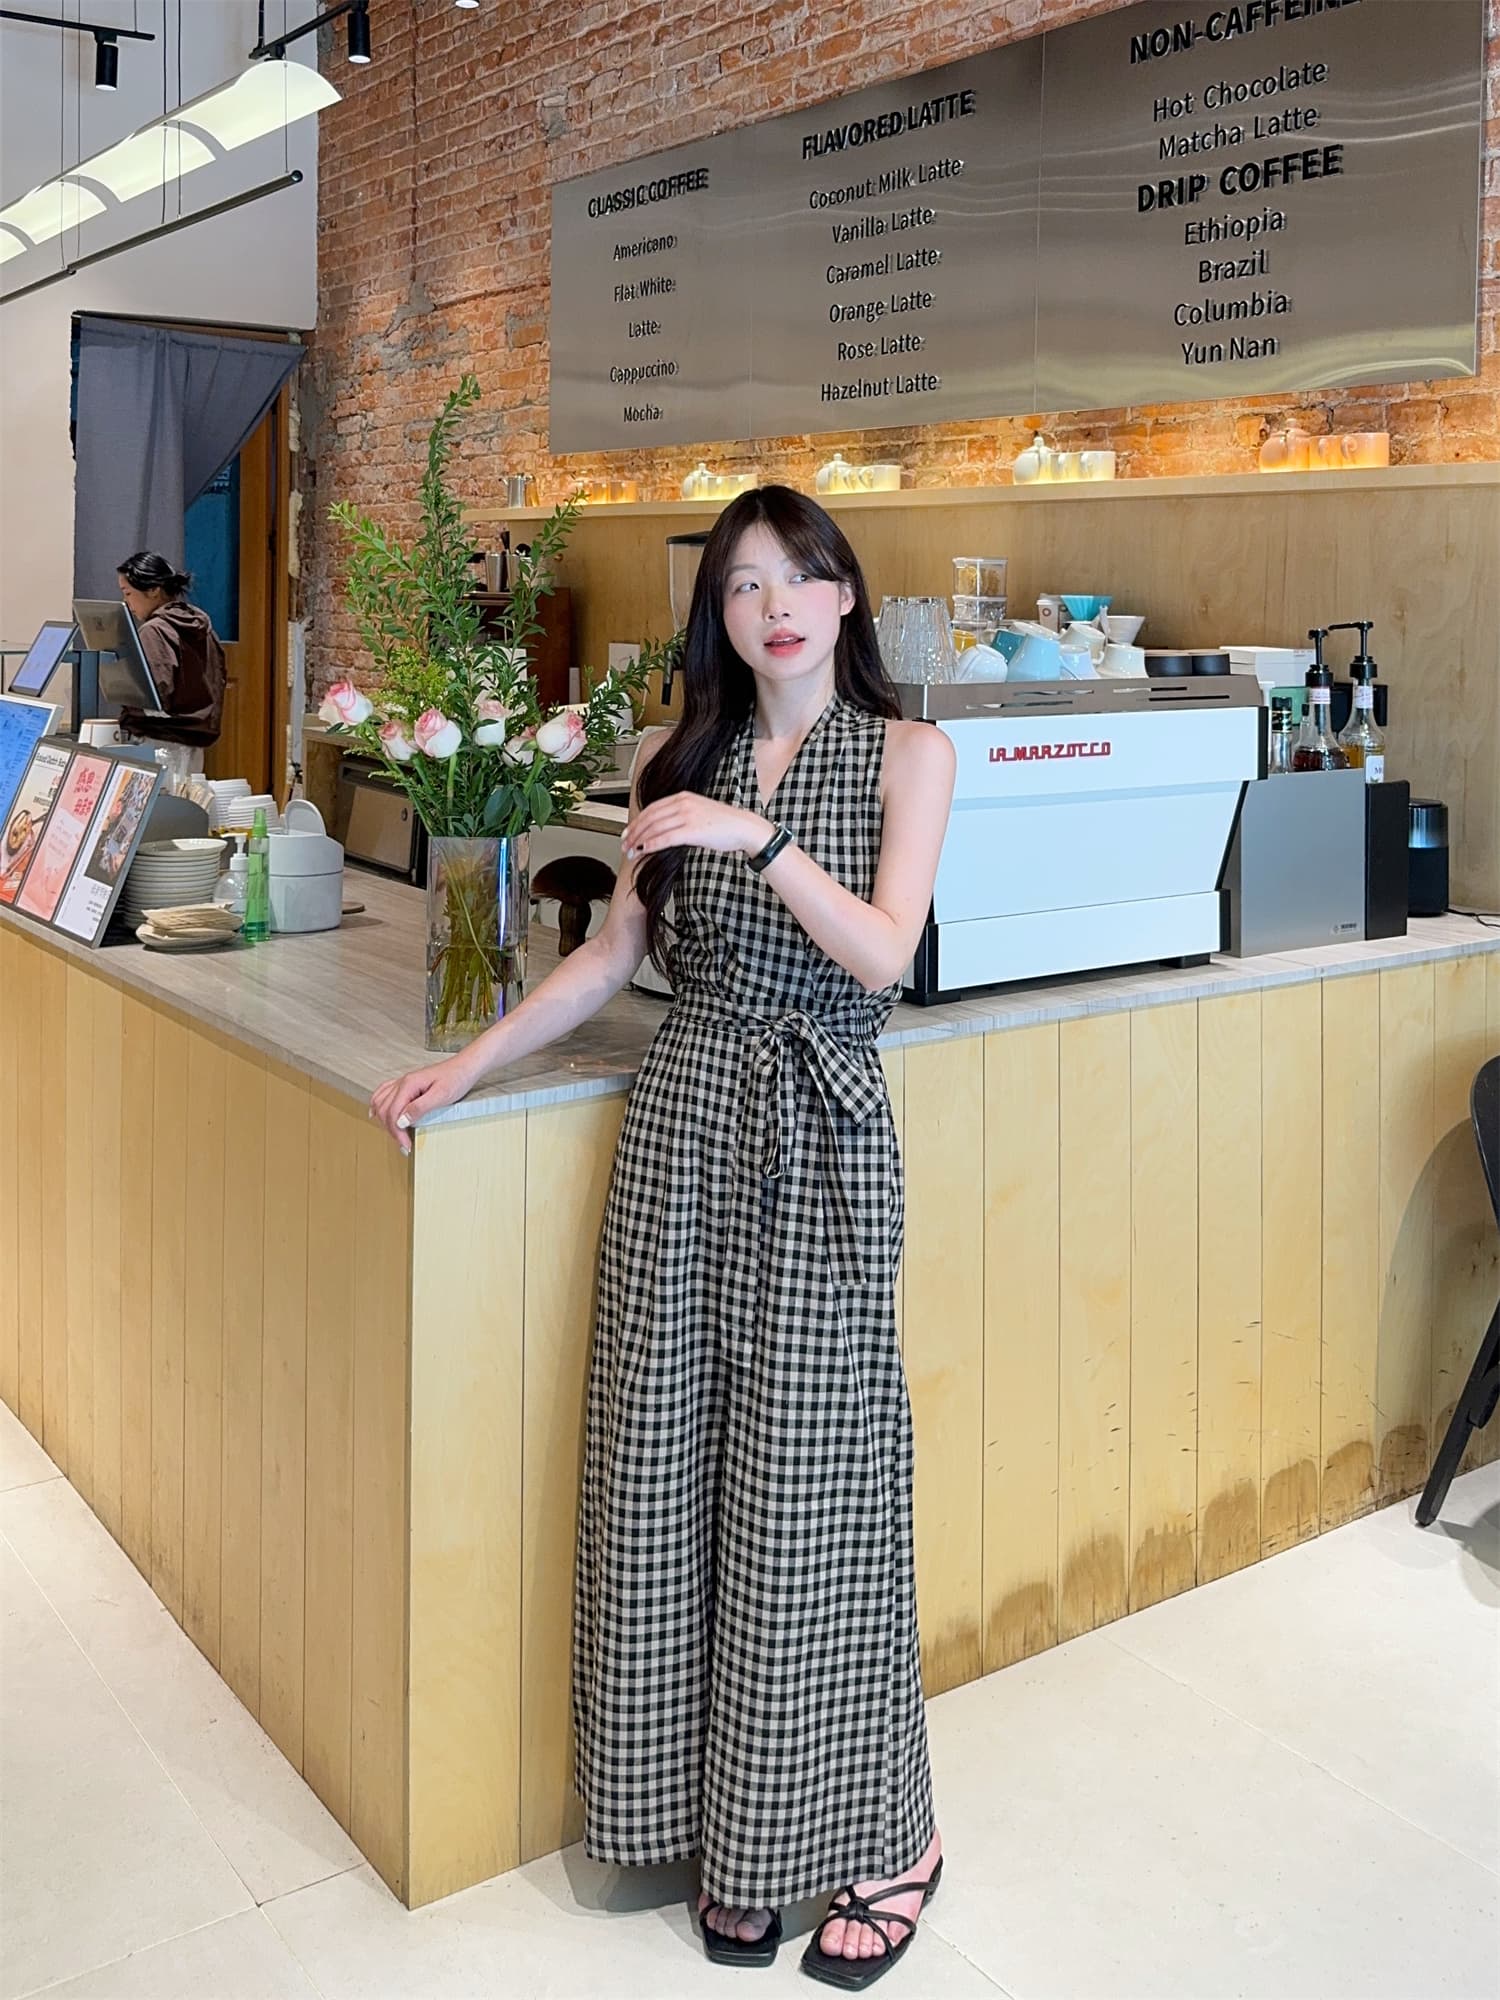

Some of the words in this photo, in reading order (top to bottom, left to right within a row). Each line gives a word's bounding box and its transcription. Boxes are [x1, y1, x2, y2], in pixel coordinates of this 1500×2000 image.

[1130, 0, 1361, 63] NON-CAFFEI
[1153, 92, 1193, 122] Hot
[1203, 62, 1326, 109] Chocolate
[802, 112, 901, 160] FLAVORED
[907, 89, 975, 130] LATTE
[1159, 124, 1243, 160] Matcha
[1254, 107, 1317, 140] Latte
[588, 185, 646, 217] CLASSIC
[648, 168, 708, 202] COFFEE
[809, 178, 873, 209] Coconut
[878, 168, 912, 194] Milk
[918, 158, 962, 184] Latte
[1137, 174, 1206, 212] DRIP
[1219, 145, 1343, 196] COFFEE
[832, 216, 884, 243] Vanilla
[891, 206, 933, 231] Latte
[1184, 208, 1284, 245] Ethiopia
[613, 235, 675, 261] Americano
[826, 254, 889, 284] Caramel
[896, 248, 938, 271] Latte
[1199, 250, 1266, 283] Brazil
[614, 285, 636, 302] Flat
[640, 277, 672, 296] White
[829, 302, 885, 323] Orange
[890, 291, 932, 313] Latte
[1174, 291, 1288, 326] Columbia
[629, 321, 658, 337] Latte
[837, 342, 873, 361] Rose
[880, 333, 921, 355] Latte
[1181, 342, 1222, 365] Yun
[1229, 336, 1276, 360] Nan
[610, 361, 676, 384] Cappuccino
[821, 377, 889, 402] Hazelnut
[896, 373, 938, 395] Latte
[623, 404, 660, 422] Mocha
